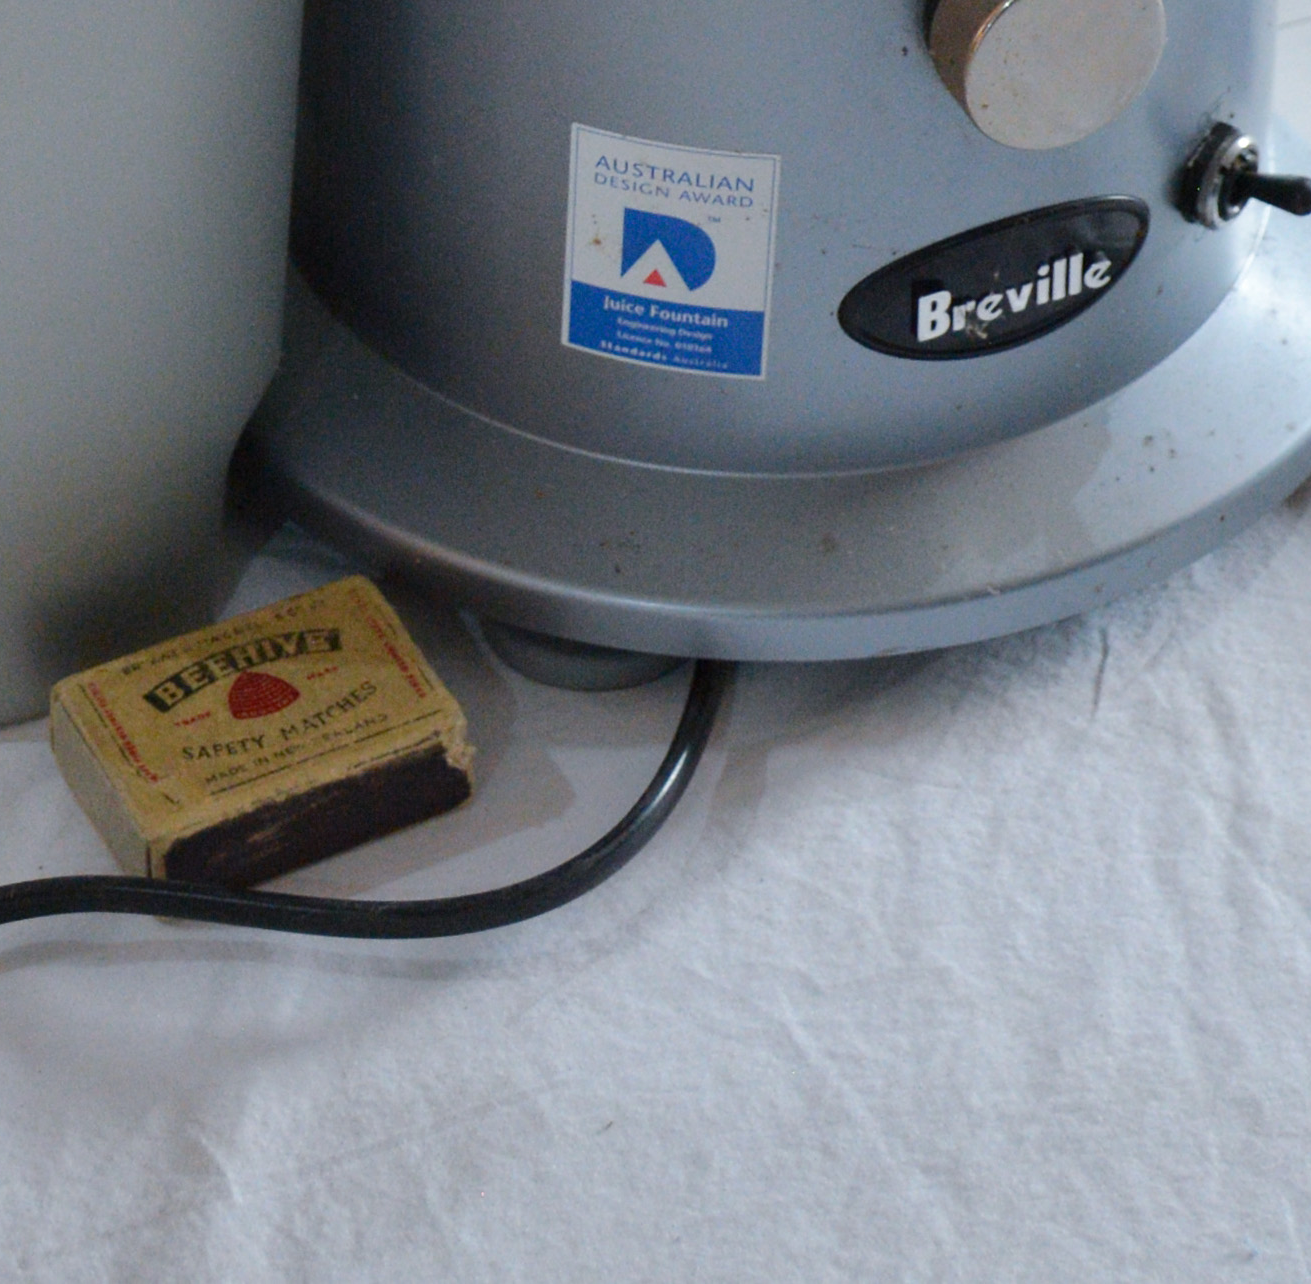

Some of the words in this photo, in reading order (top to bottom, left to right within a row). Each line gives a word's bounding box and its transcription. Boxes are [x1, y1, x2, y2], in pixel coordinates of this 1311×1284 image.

[594, 171, 670, 198] DESIGN
[678, 189, 754, 208] AWARD
[595, 155, 755, 193] AUSTRALIAN
[603, 295, 645, 316] Juice
[650, 304, 729, 328] Fountain
[917, 252, 1112, 343] Breville
[601, 339, 667, 362] Standards
[149, 629, 335, 709] BEEHIVE
[181, 734, 266, 761] SAFETY
[280, 680, 378, 741] MATCHES
[205, 765, 248, 784] MADE
[253, 756, 270, 767] IN
